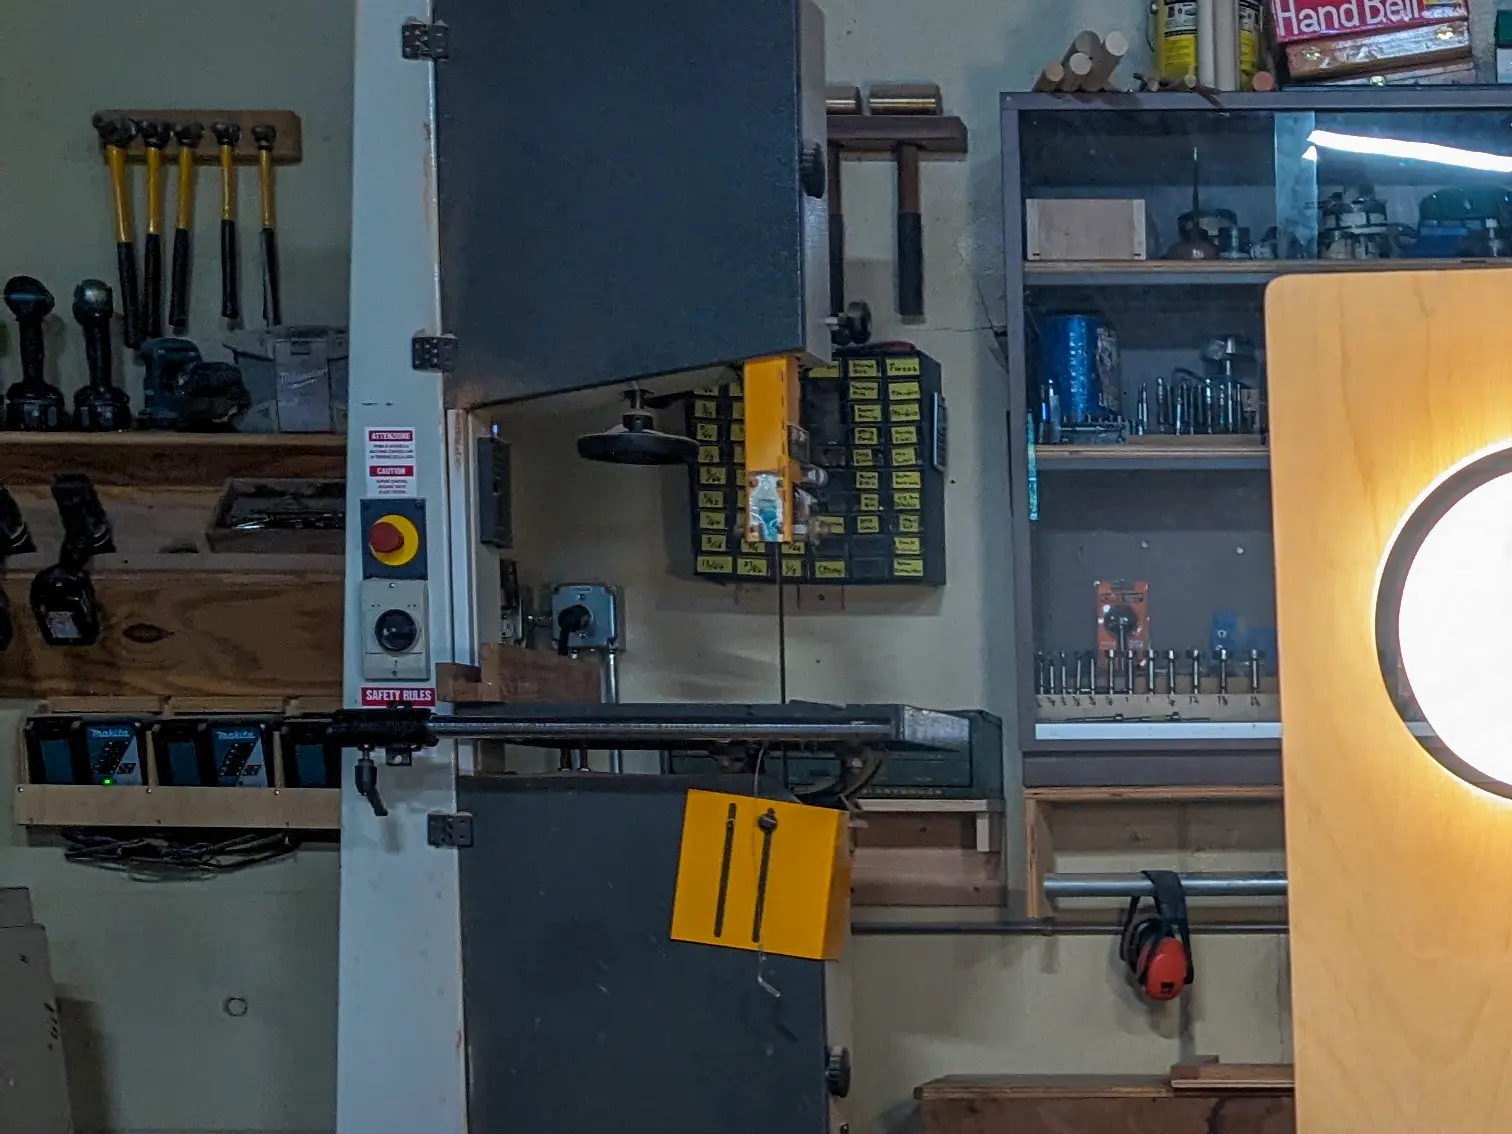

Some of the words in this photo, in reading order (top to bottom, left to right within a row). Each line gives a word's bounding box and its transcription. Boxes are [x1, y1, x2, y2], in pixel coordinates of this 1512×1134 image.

[1275, 0, 1360, 36] Hand
[1365, 0, 1420, 27] Bell
[366, 689, 400, 701] SAFETY
[403, 689, 432, 701] RULES
